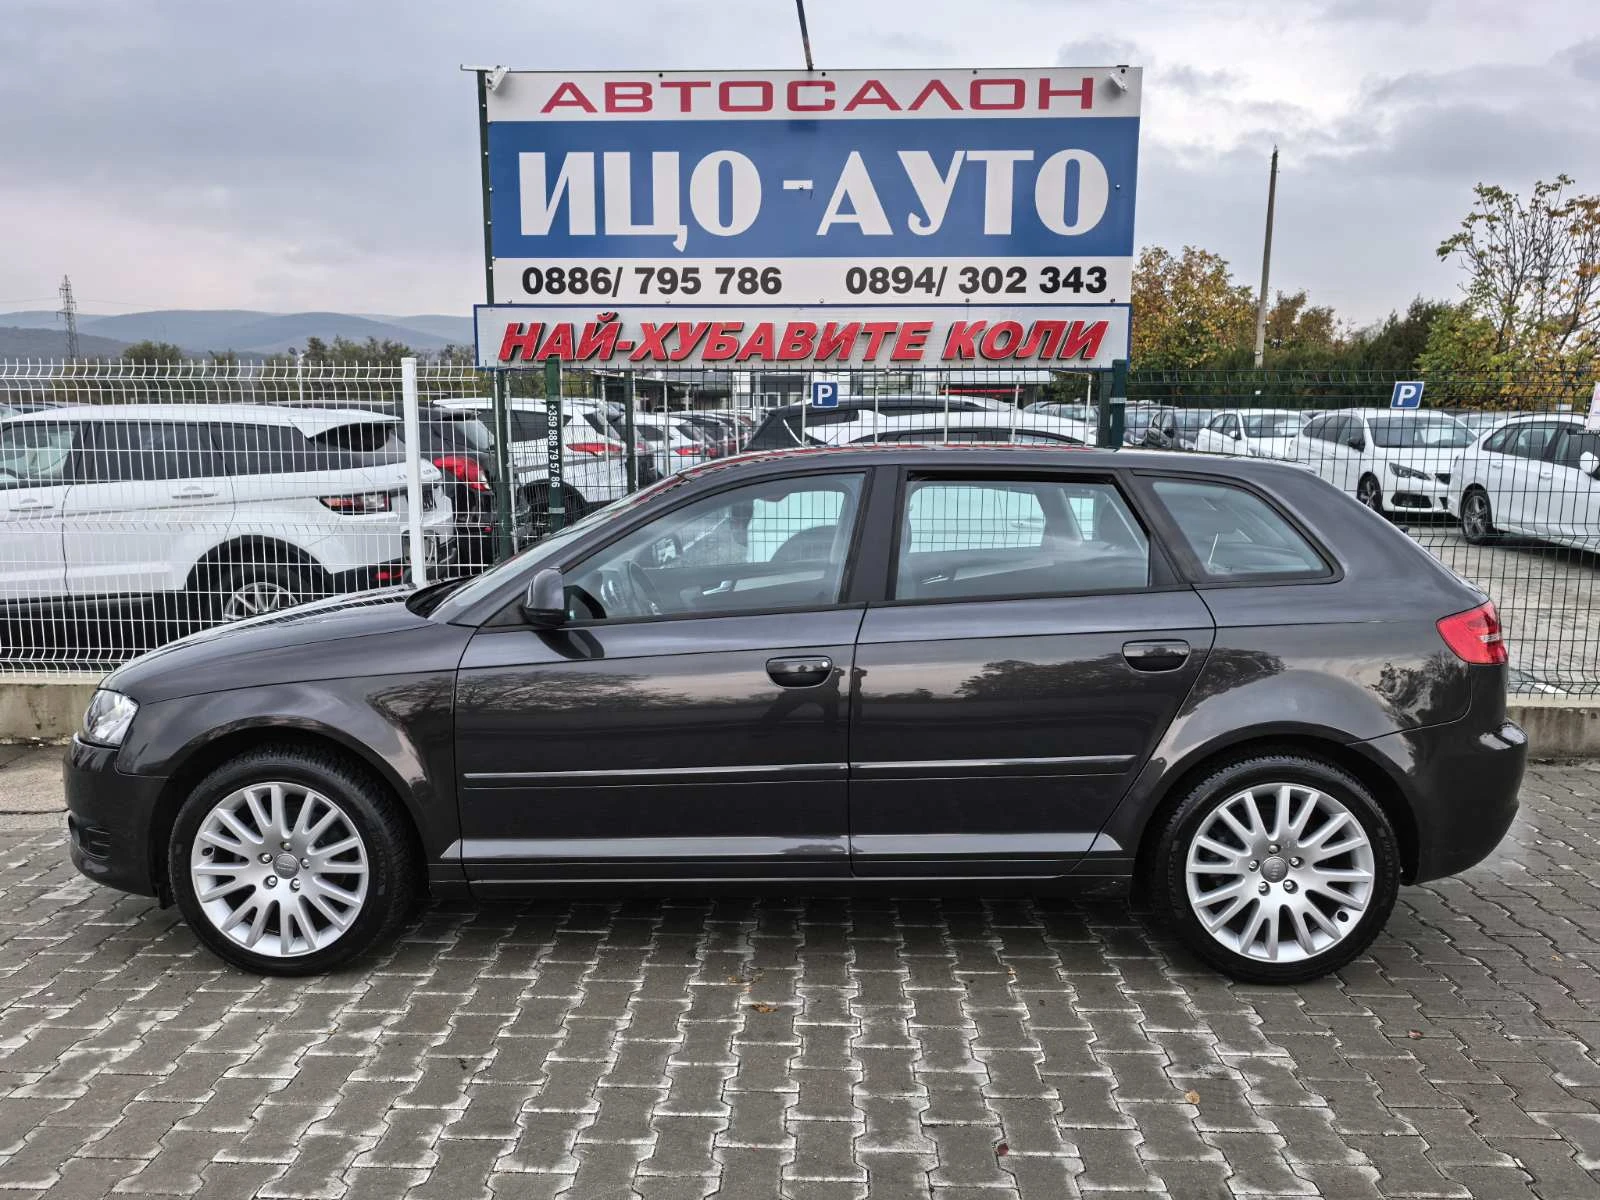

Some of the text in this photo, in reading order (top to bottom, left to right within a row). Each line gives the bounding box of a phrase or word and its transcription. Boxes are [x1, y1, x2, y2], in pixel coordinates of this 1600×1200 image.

[540, 77, 1094, 113] АВТОСАЛОН
[521, 266, 783, 297] 0886/ 795 786
[845, 265, 1107, 296] 0894/ 302 343
[498, 311, 1110, 361] НАЙ-ХУБАВИТЕ КОЛИ
[817, 384, 833, 405] P
[1397, 384, 1417, 406] P
[548, 404, 561, 488] +359 886 79 57 86
